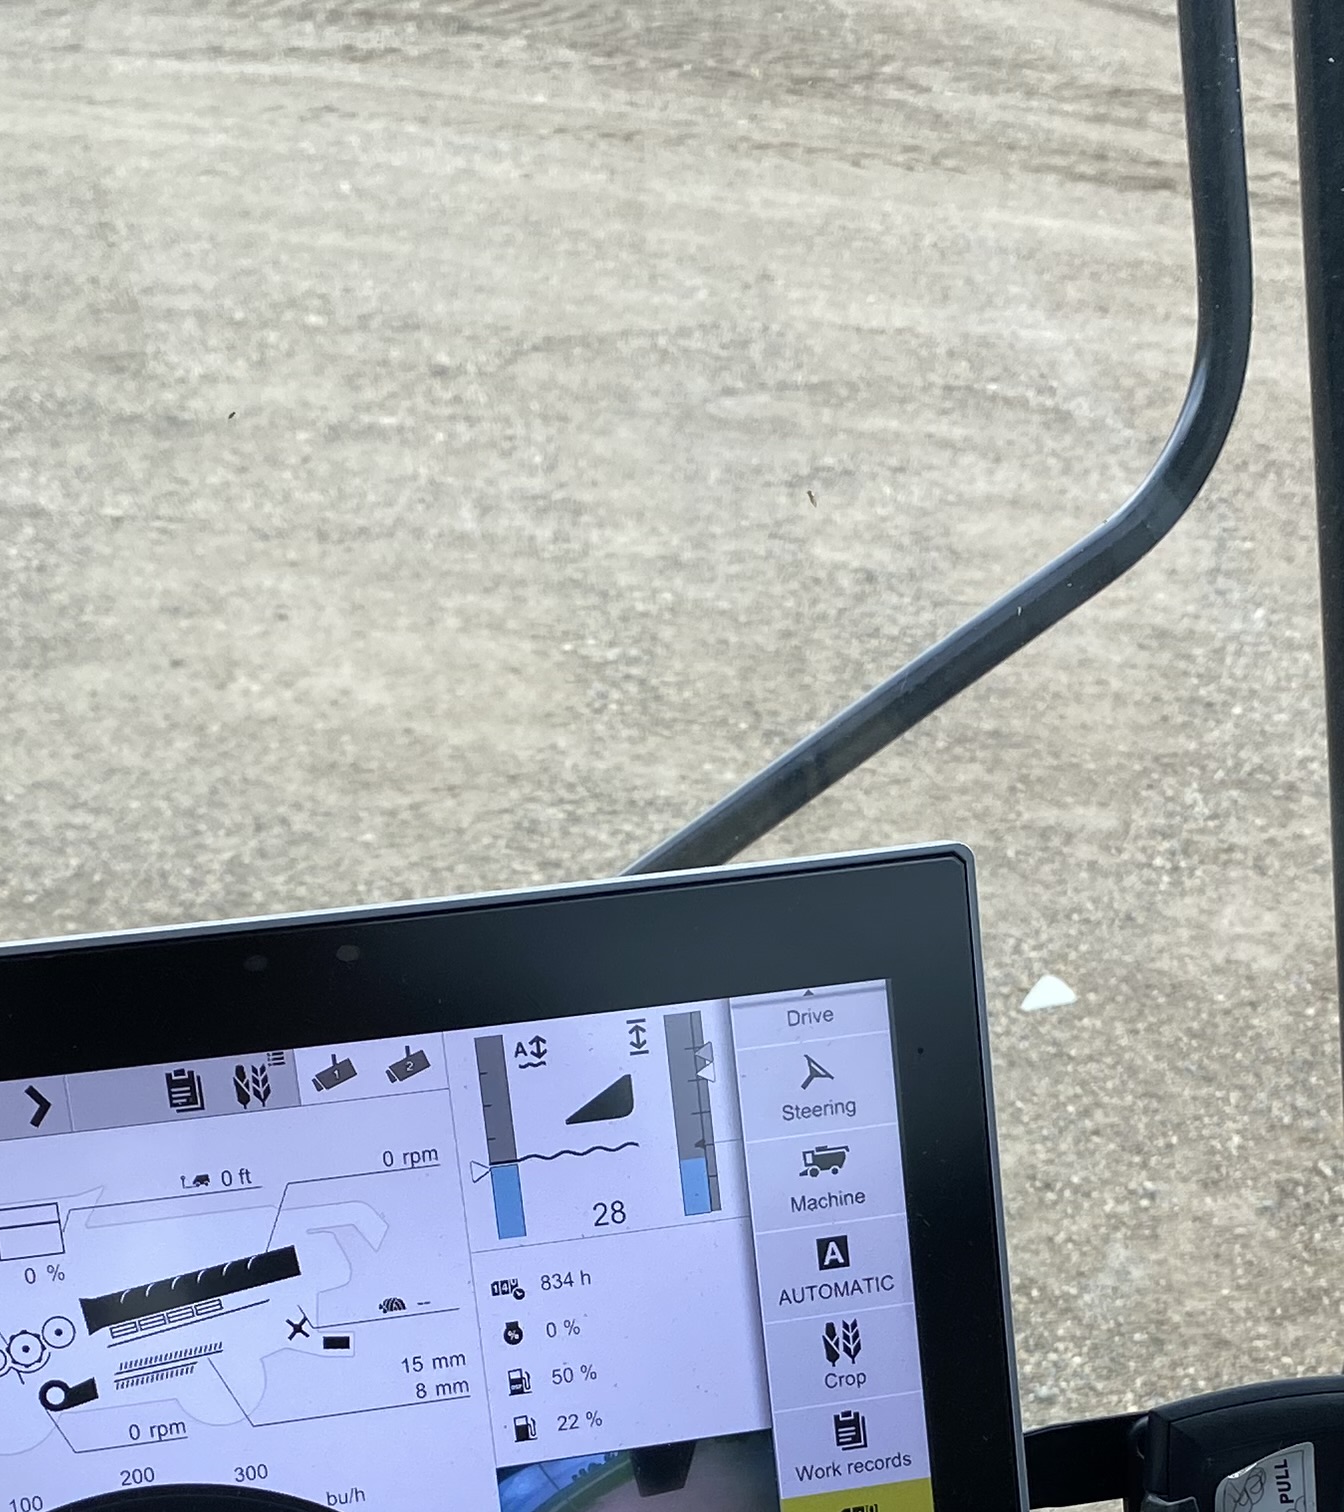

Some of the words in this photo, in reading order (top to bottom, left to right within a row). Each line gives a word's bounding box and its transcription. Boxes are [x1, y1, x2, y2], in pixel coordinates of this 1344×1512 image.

[787, 1007, 835, 1027] Drive
[782, 1099, 857, 1122] Steering
[383, 1150, 394, 1167] 0
[403, 1148, 439, 1168] rpm
[221, 1170, 233, 1186] 0
[240, 1169, 252, 1186] ft
[791, 1189, 866, 1213] Machine
[593, 1201, 627, 1227] 28
[25, 1268, 36, 1284] 0
[47, 1264, 65, 1282] %
[540, 1272, 574, 1290] 834
[580, 1270, 591, 1287] h
[779, 1275, 895, 1306] AUTOMATIC
[546, 1322, 557, 1338] 0
[563, 1319, 581, 1337] %
[402, 1355, 425, 1374] 15
[432, 1352, 466, 1369] mm
[551, 1367, 574, 1385] 50
[580, 1364, 597, 1382] %
[825, 1369, 868, 1390] Crop
[416, 1382, 427, 1399] 8
[436, 1379, 469, 1396] mm
[129, 1424, 141, 1441] 0
[149, 1419, 187, 1440] rpm
[557, 1413, 579, 1431] 22
[586, 1410, 603, 1428] %
[120, 1466, 155, 1487] 200
[234, 1463, 268, 1483] 300
[795, 1460, 843, 1483] Work
[848, 1451, 912, 1475] records
[1274, 1459, 1295, 1504] PULL
[327, 1487, 366, 1507] bu/h
